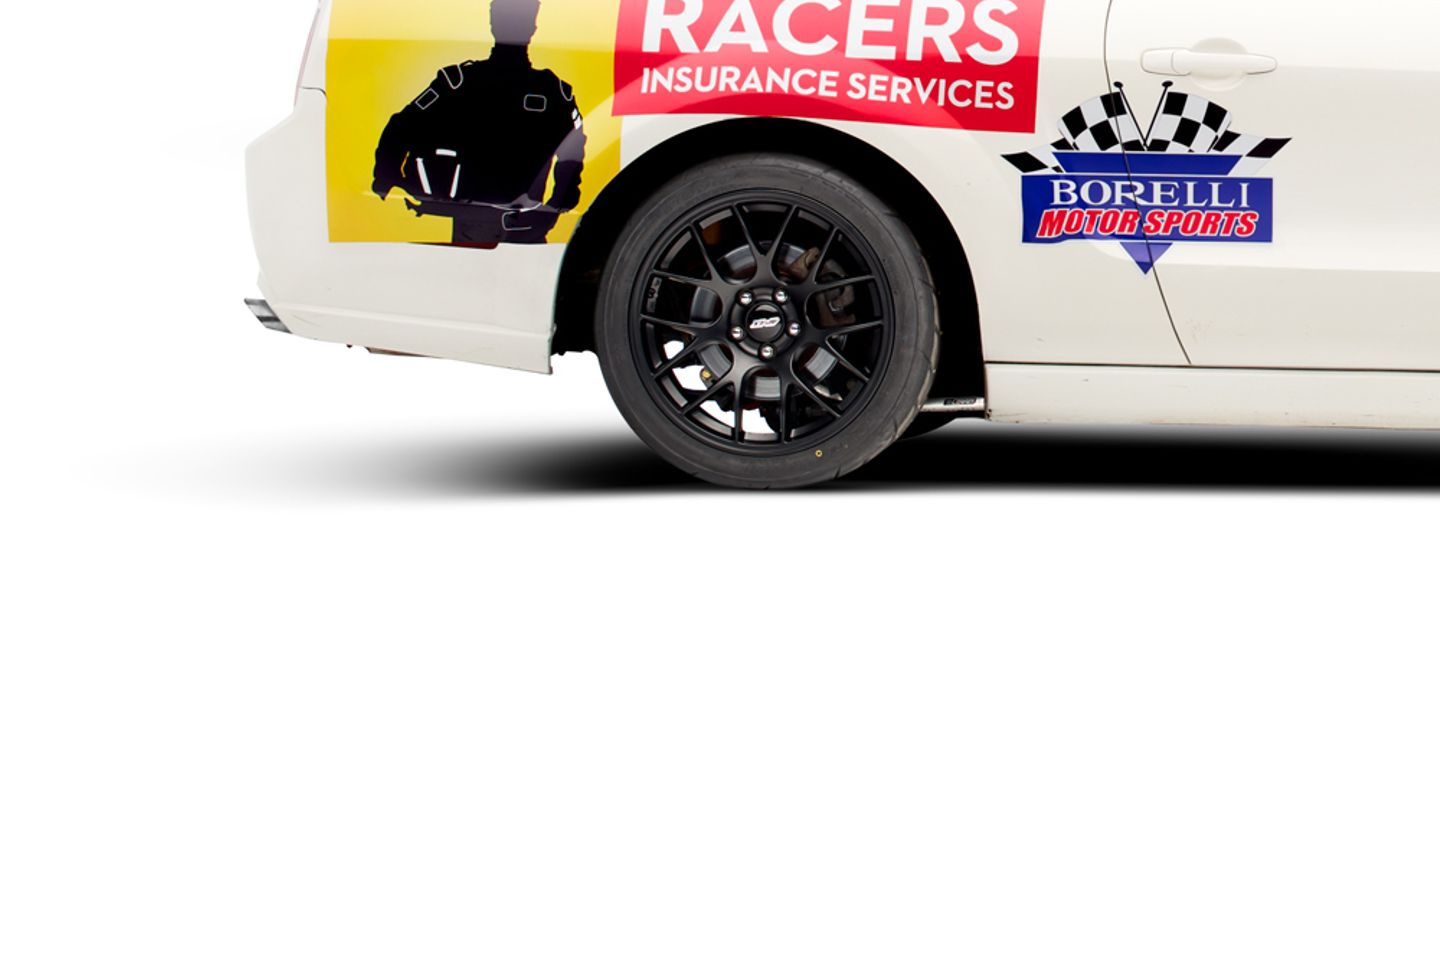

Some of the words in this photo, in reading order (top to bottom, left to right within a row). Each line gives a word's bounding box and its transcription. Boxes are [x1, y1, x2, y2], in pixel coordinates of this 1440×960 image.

[640, 66, 839, 98] INSURANCE
[846, 72, 1015, 110] SERVICES
[1049, 178, 1250, 208] BORELLI
[1036, 209, 1140, 238] MOTOR
[1142, 210, 1259, 237] SPORTS
